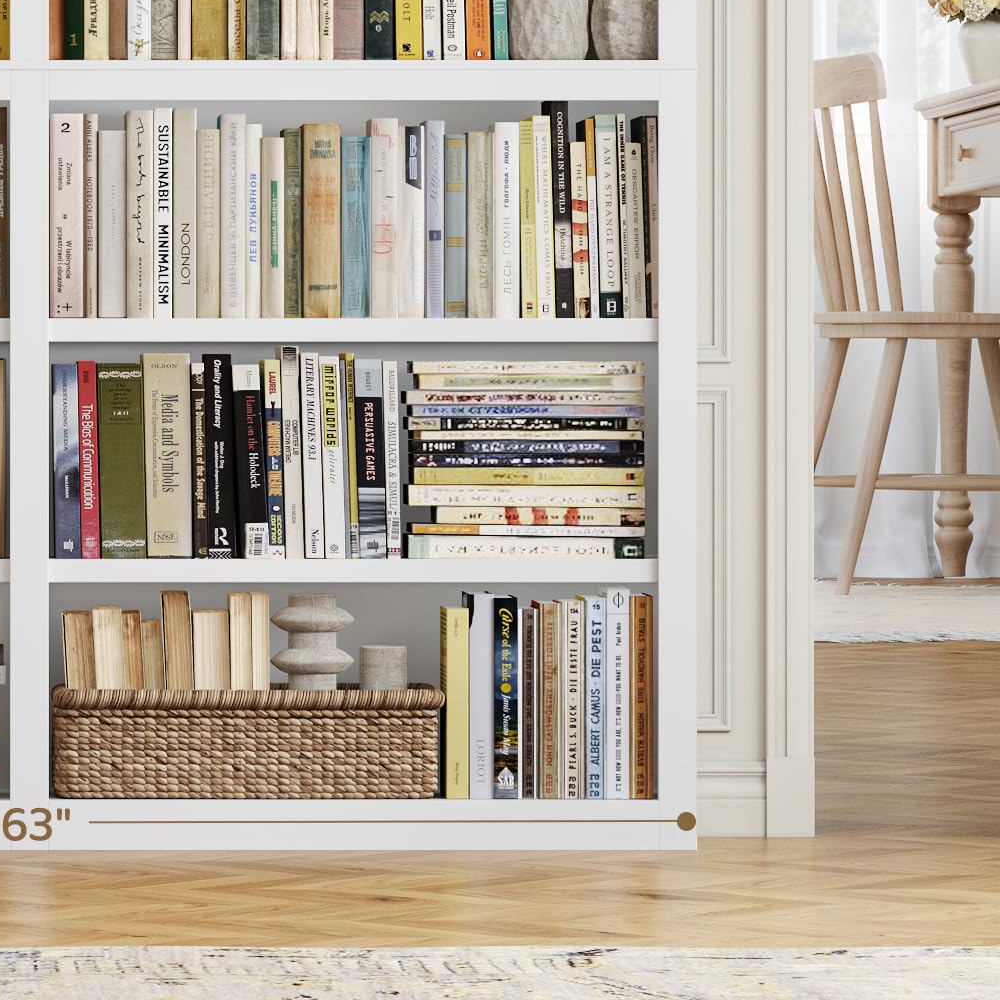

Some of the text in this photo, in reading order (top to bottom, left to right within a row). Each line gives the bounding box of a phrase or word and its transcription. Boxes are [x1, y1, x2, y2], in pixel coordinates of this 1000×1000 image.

[62, 123, 70, 133] 2
[604, 148, 612, 165] AM
[557, 161, 564, 169] IN
[158, 125, 169, 304] SUSTAINABLE MINIMALISM
[605, 185, 613, 244] STRANGE
[181, 223, 190, 285] LONDON
[606, 251, 614, 287] LOOP
[213, 360, 221, 383] Orality
[82, 404, 93, 419] The
[82, 421, 94, 438] Bias
[214, 400, 222, 428] Literacy
[306, 358, 316, 460] LITERARY MACHINES 93.1
[324, 366, 336, 445] mirror worlds
[159, 395, 178, 492] Media and Symbols
[246, 396, 259, 488] Hamlet on the Holodeck
[365, 403, 375, 480] PERSUASIVE GAMES
[83, 449, 94, 509] Communication
[499, 608, 513, 681] Curse of the Exile
[502, 694, 511, 713] Janis
[591, 620, 601, 765] ALBERT CAMUS DIE PEST
[502, 738, 510, 755] May
